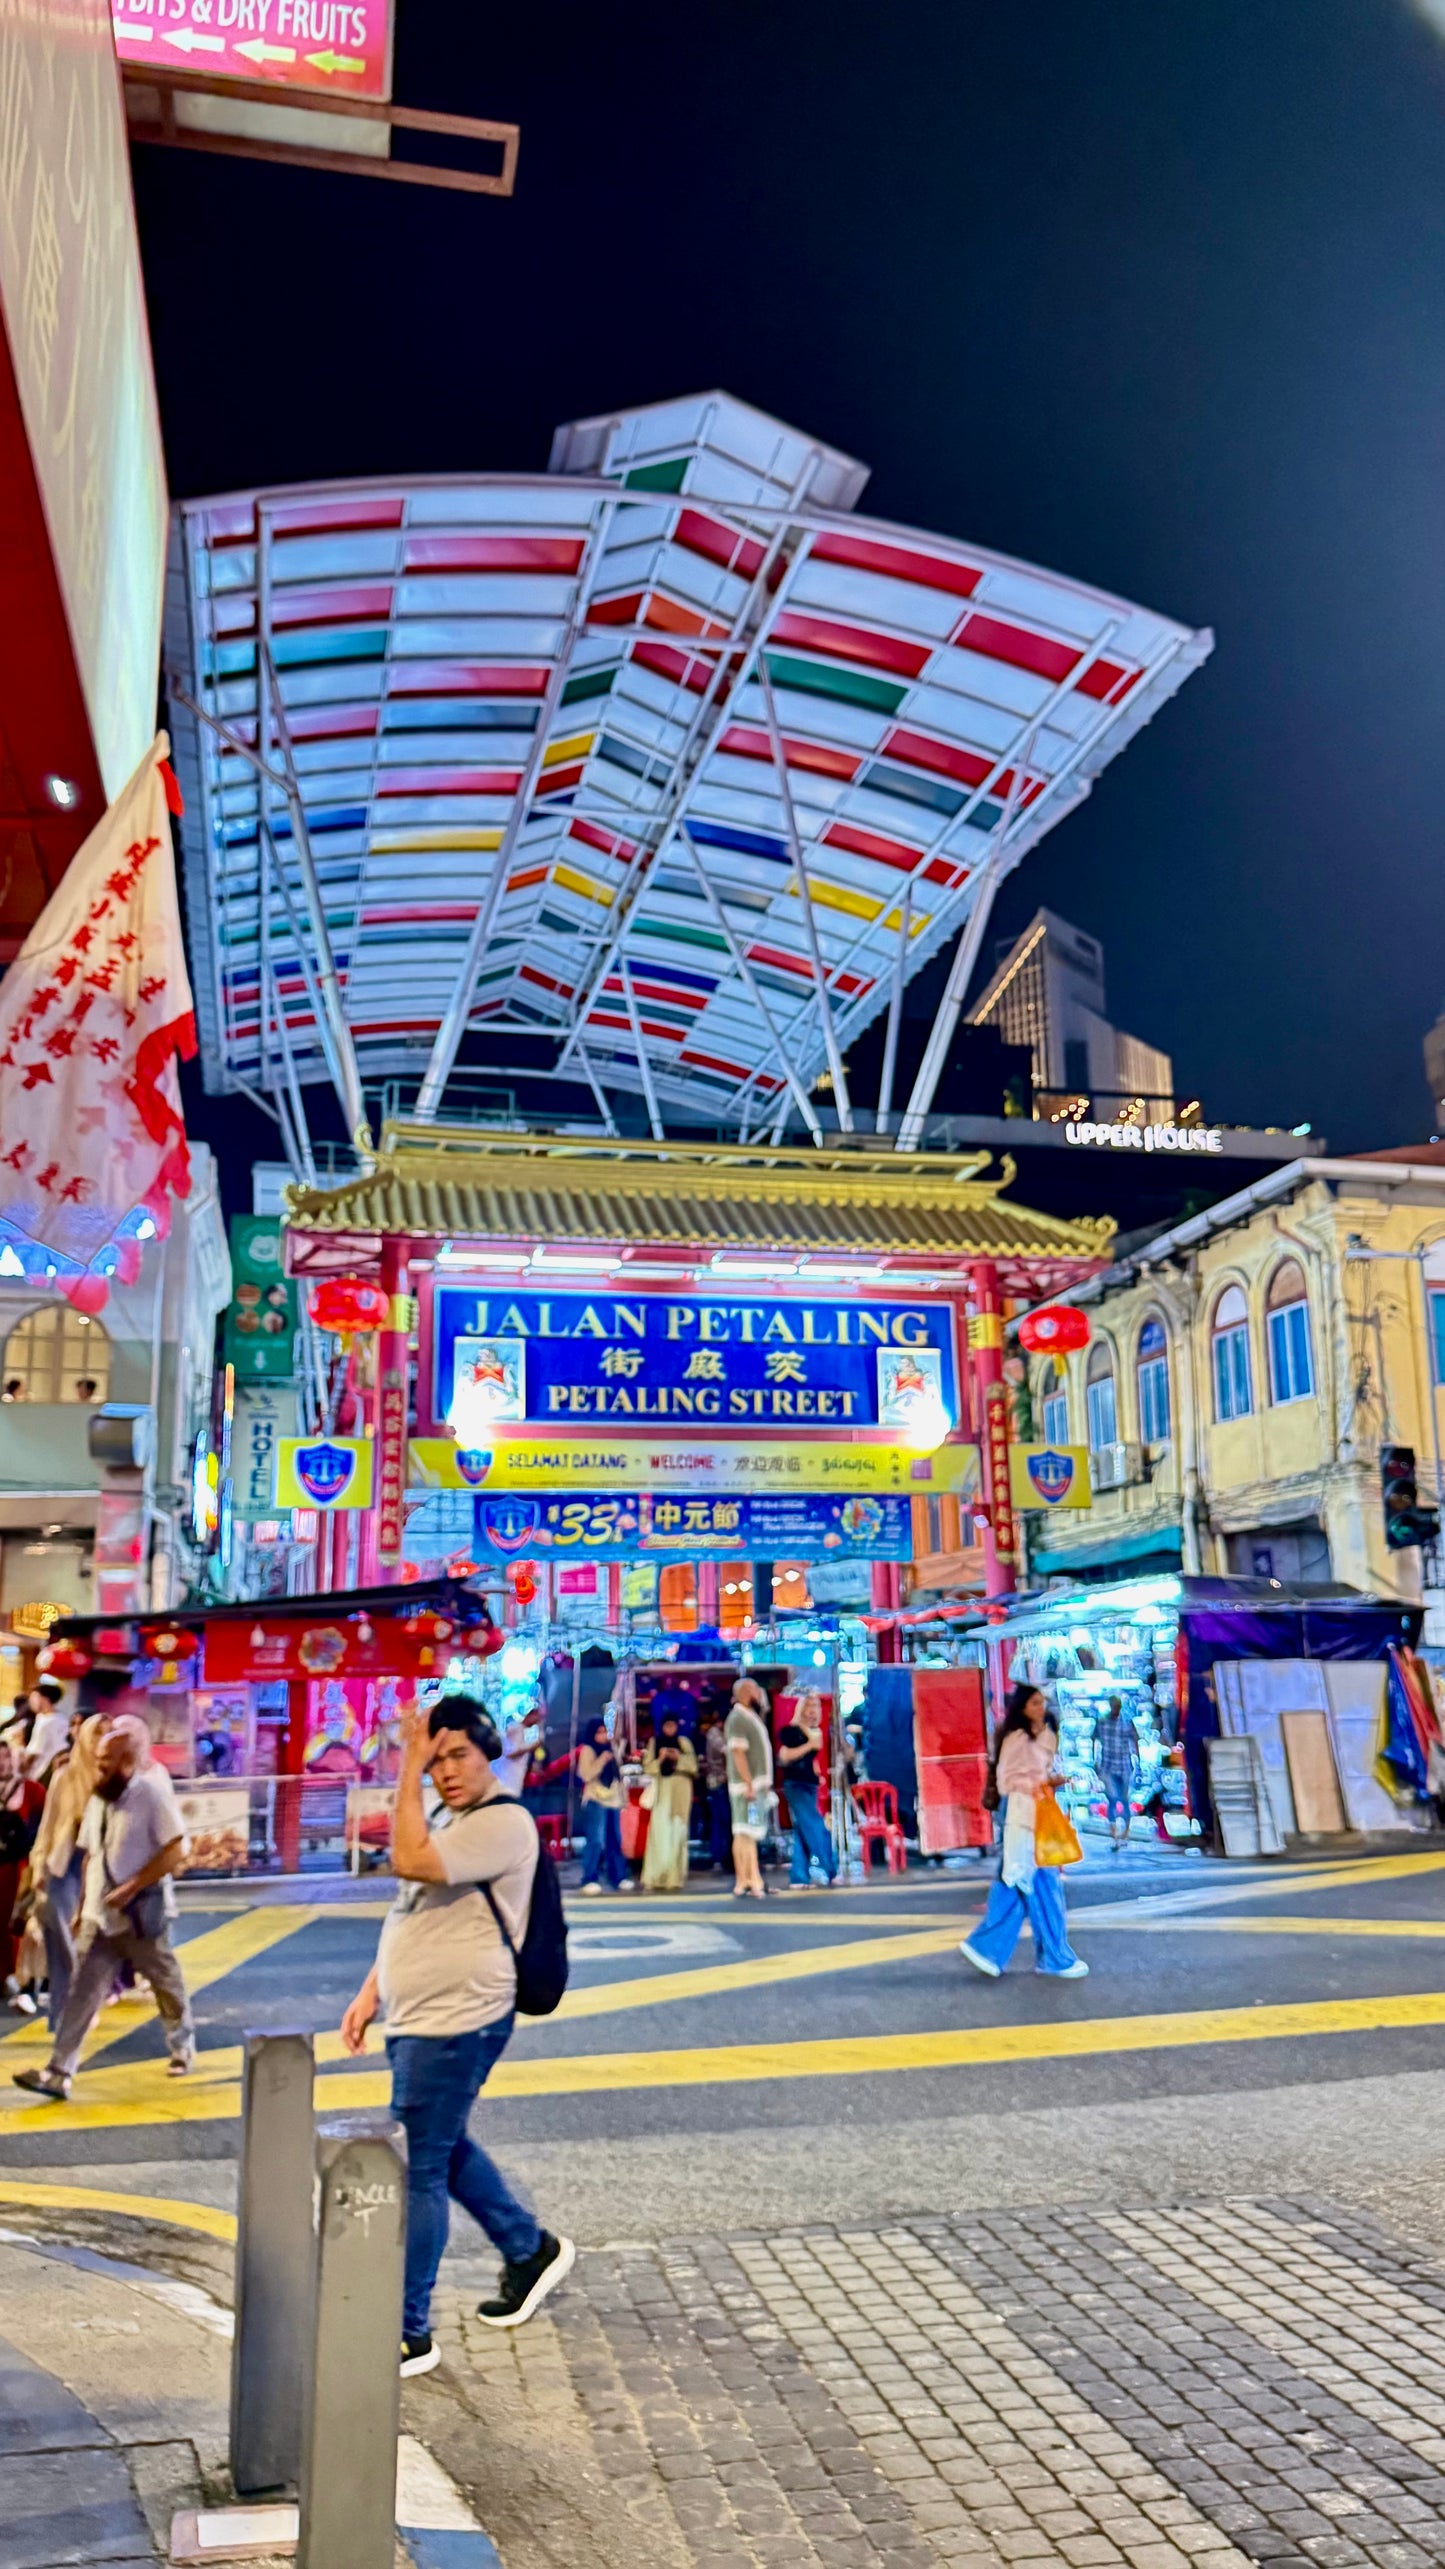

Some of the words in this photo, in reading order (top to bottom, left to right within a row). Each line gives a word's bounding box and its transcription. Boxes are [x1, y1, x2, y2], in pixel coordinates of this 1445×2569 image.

[191, 0, 213, 24] &
[217, 0, 273, 32] DRY
[276, 0, 367, 47] FRUITS
[1065, 1122, 1143, 1148] UPPER
[1143, 1123, 1224, 1152] HOUSE
[465, 1301, 646, 1338] JALAN
[666, 1306, 930, 1347] PETALING
[548, 1385, 721, 1415] PETALING
[729, 1388, 858, 1417] STREET
[251, 1422, 272, 1499] HOTEL
[508, 1453, 569, 1469] SELAMAT
[572, 1453, 627, 1470] DATANG
[648, 1454, 716, 1470] WELCOME
[655, 1500, 741, 1531] 中元節
